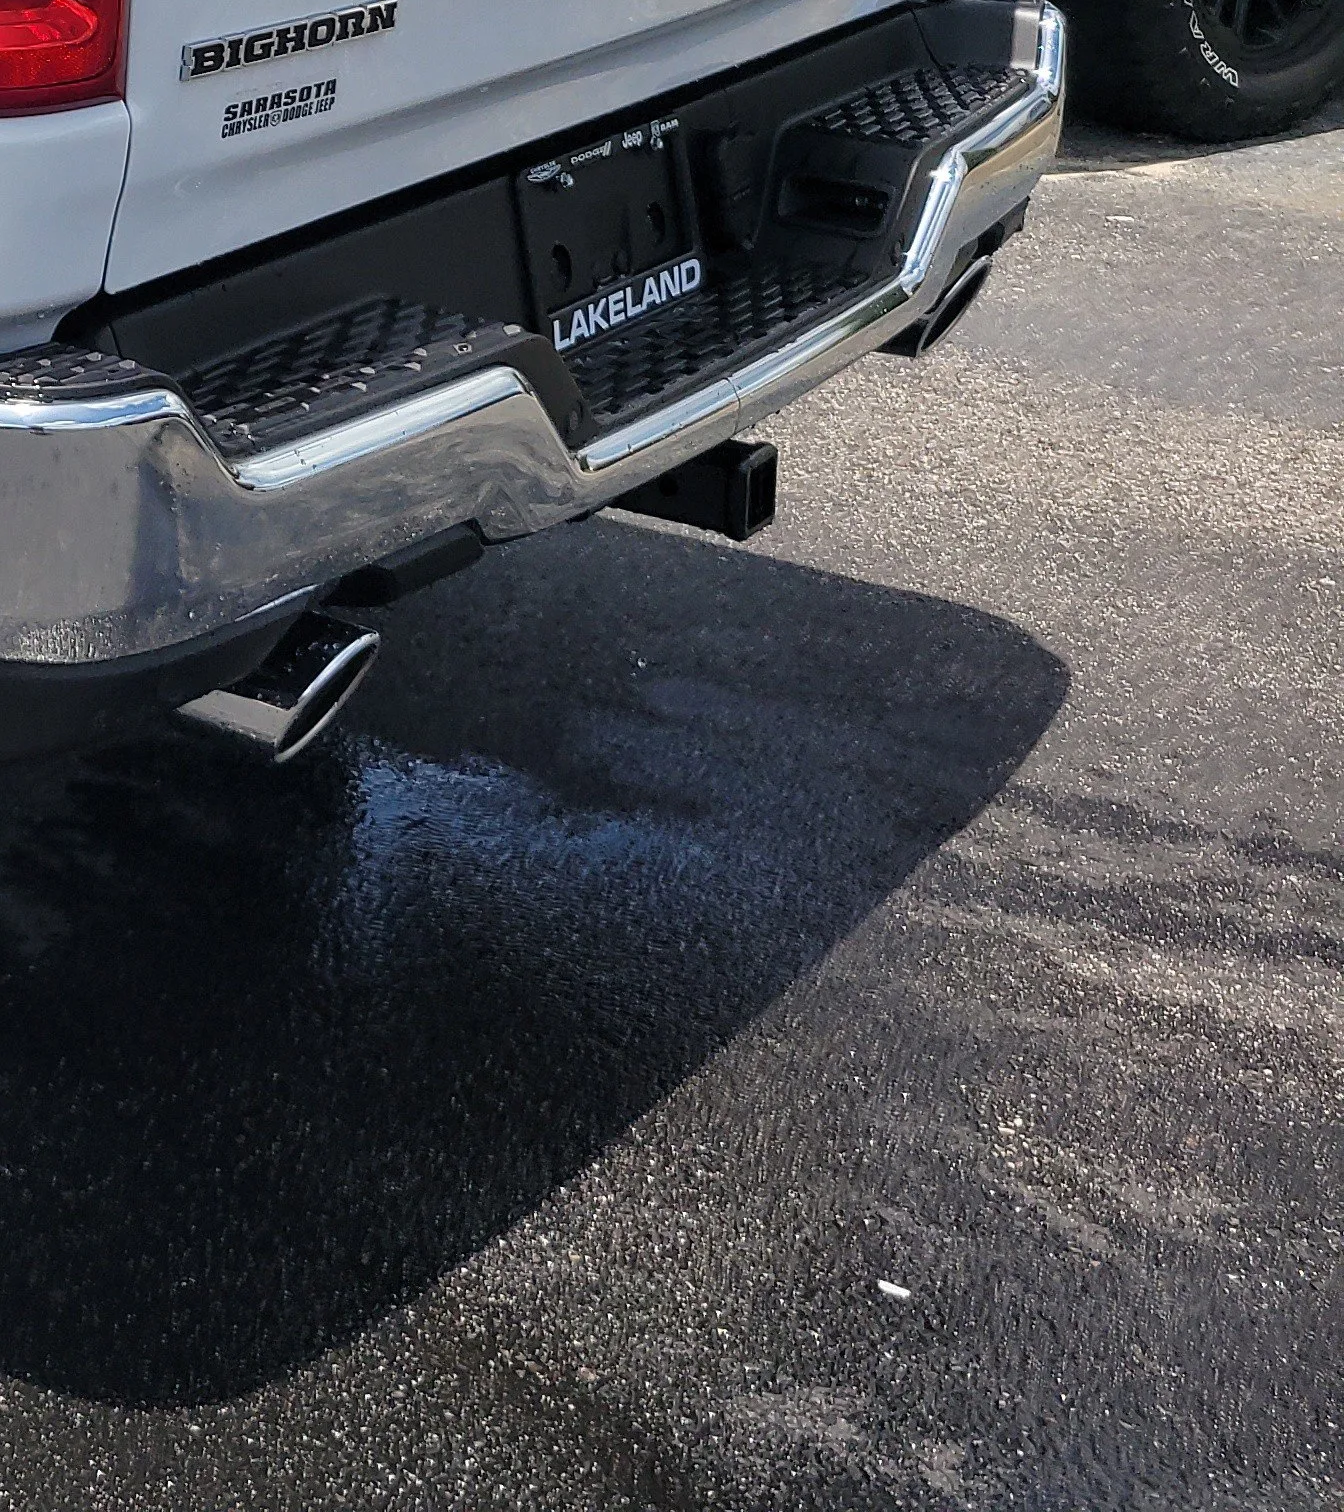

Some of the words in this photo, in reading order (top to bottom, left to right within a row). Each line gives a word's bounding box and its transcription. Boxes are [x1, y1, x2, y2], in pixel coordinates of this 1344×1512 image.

[221, 113, 270, 139] CHRYSLER
[281, 102, 313, 123] DODGE
[314, 96, 336, 115] JEEP
[223, 78, 337, 122] SARASOTA
[621, 130, 644, 149] Jeep
[552, 258, 701, 353] LAKELAND
